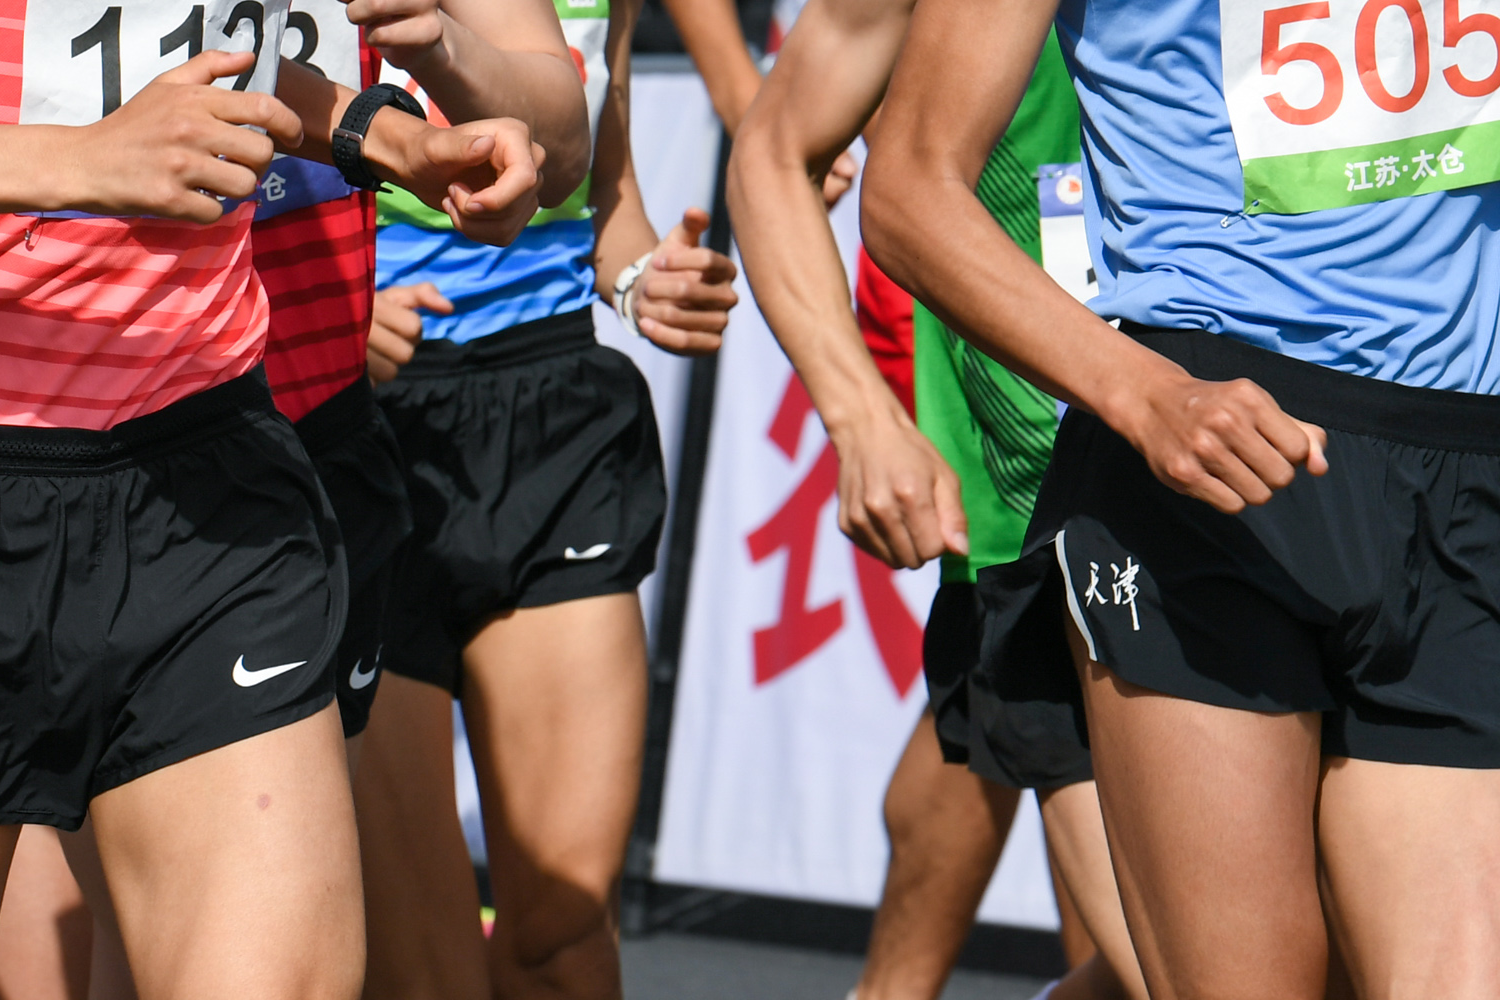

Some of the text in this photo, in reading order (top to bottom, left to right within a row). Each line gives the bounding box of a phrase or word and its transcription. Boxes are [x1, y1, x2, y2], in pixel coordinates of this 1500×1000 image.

[1344, 143, 1465, 192] 江苏·太仓
[1084, 556, 1140, 631] 天津
